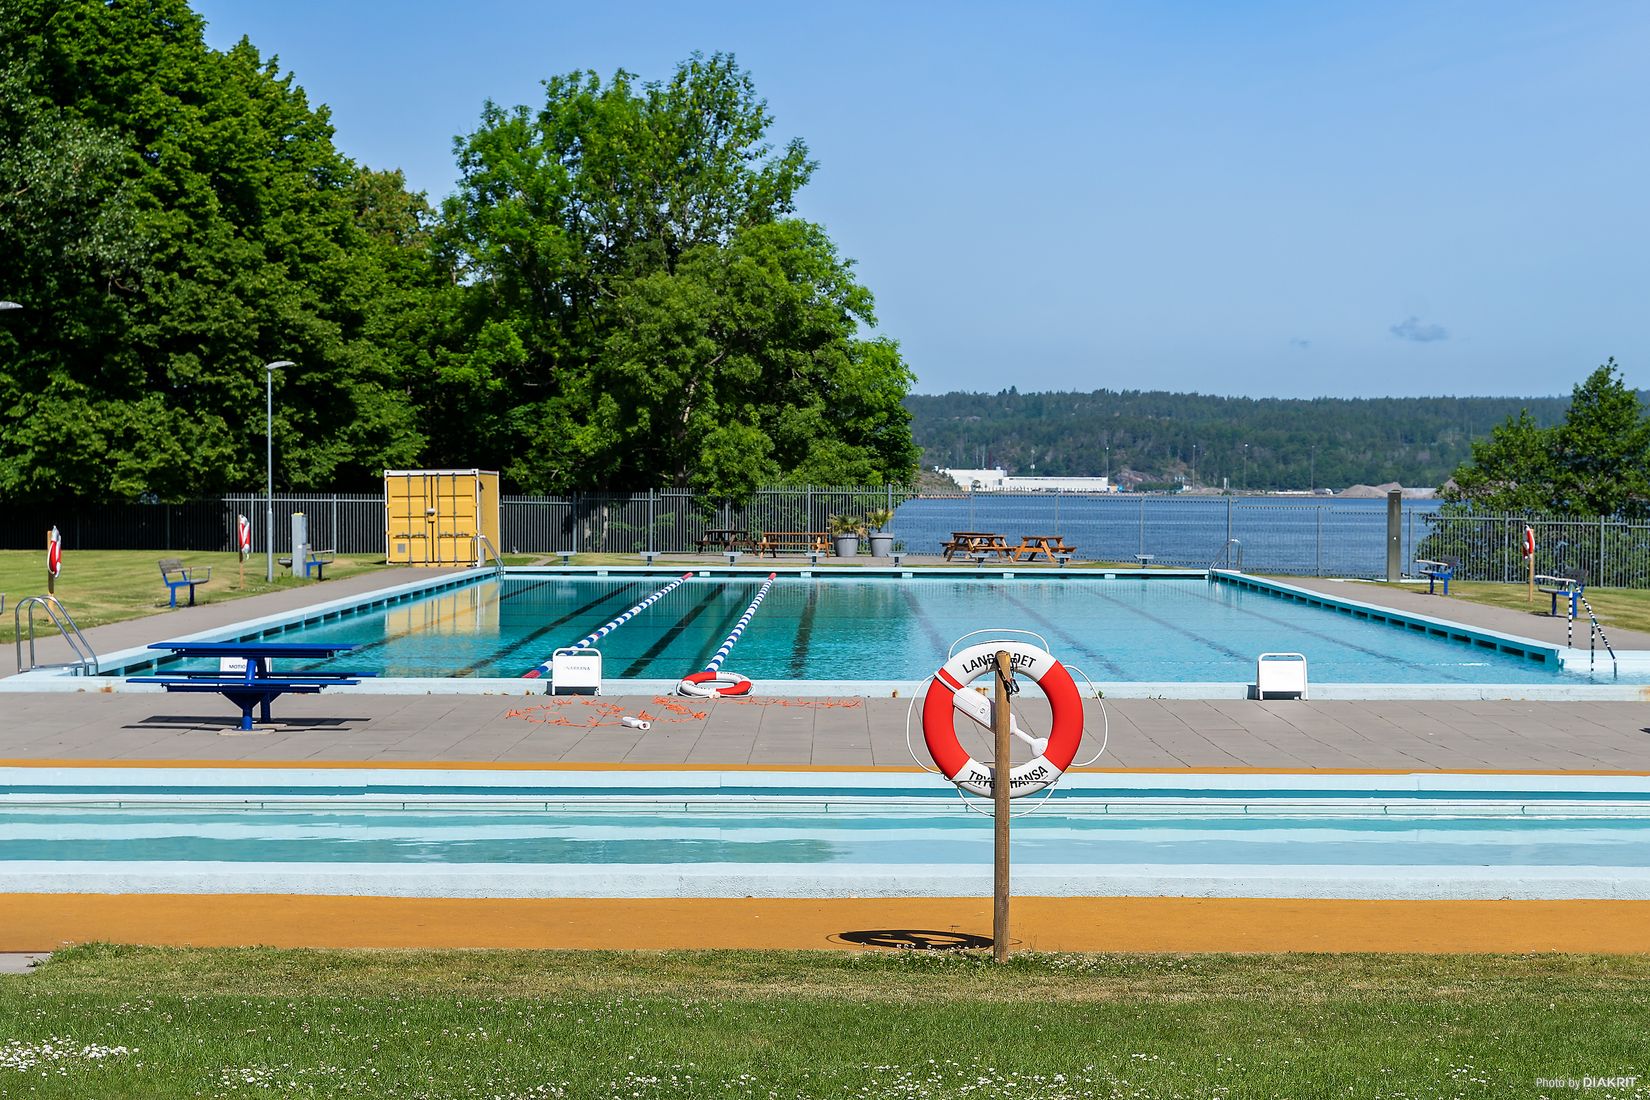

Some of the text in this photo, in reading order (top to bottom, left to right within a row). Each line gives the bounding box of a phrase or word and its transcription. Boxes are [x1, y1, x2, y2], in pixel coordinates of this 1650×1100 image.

[962, 653, 1037, 674] LANDDET
[968, 765, 1049, 789] TRYG HANSA
